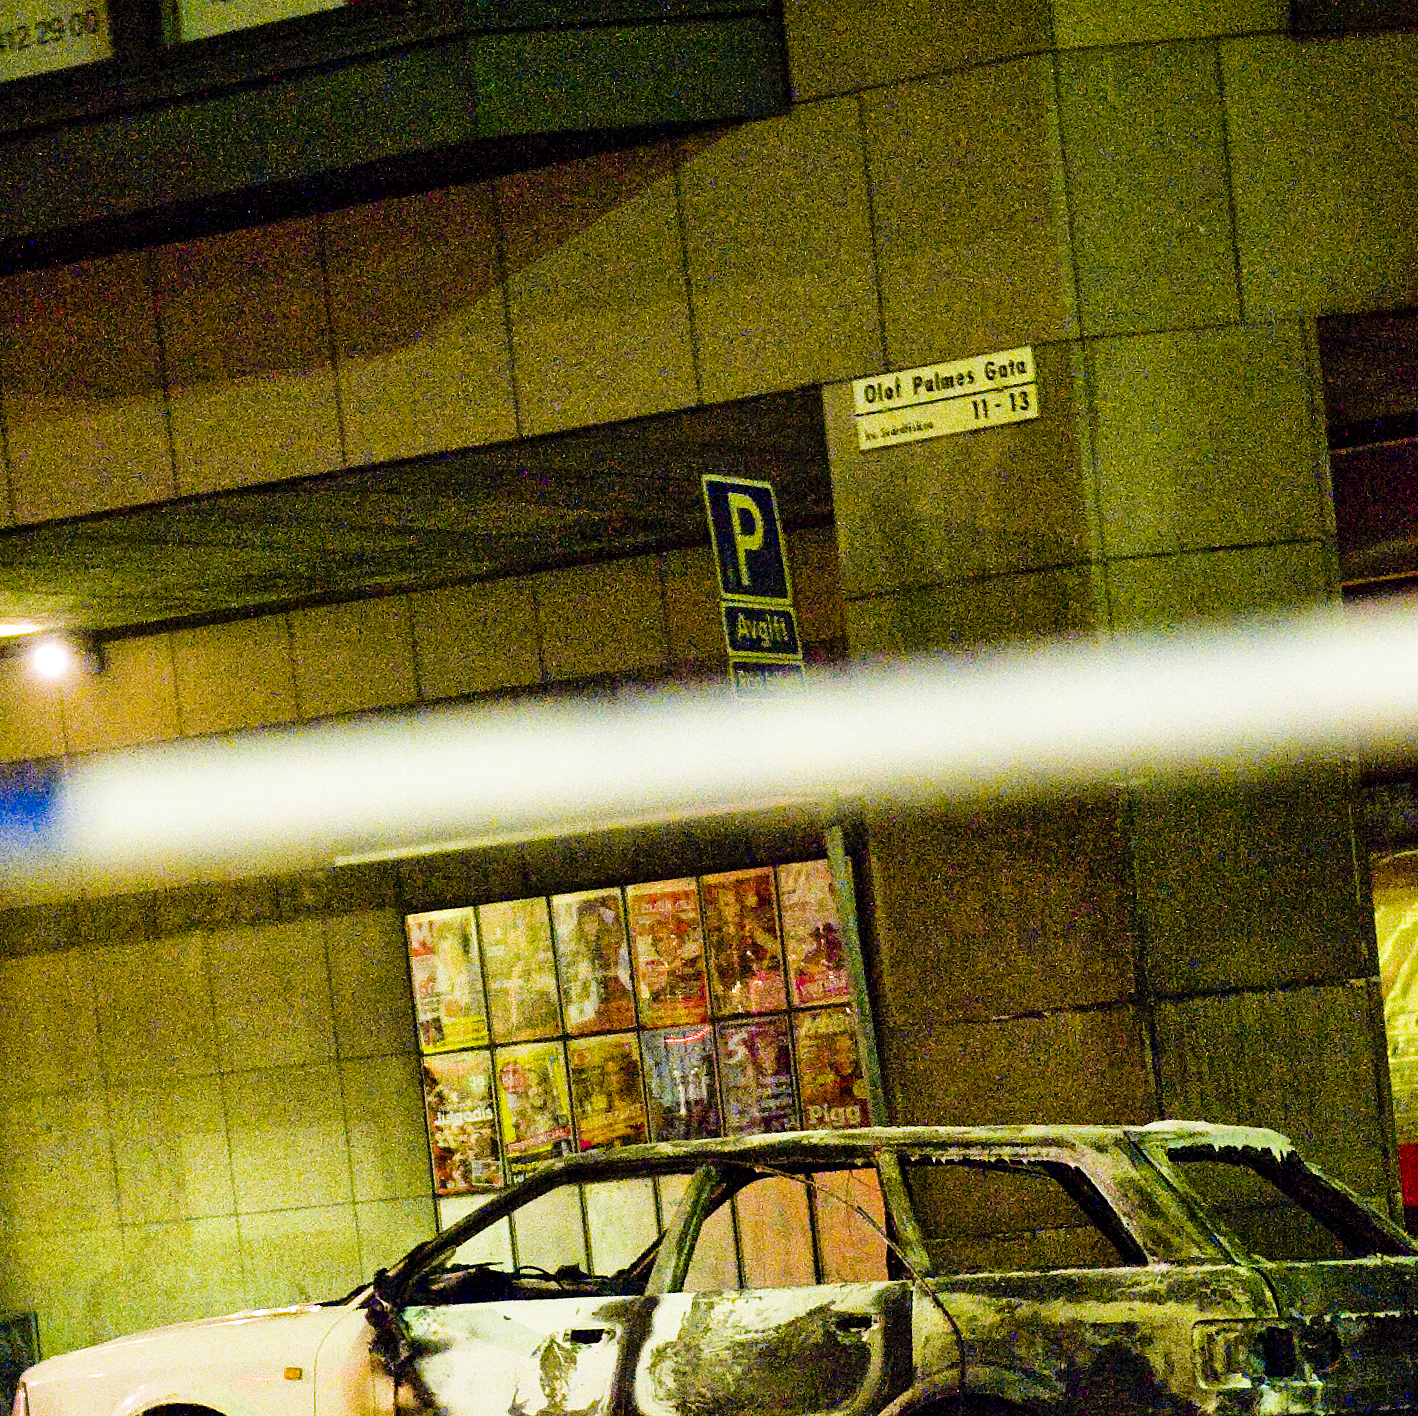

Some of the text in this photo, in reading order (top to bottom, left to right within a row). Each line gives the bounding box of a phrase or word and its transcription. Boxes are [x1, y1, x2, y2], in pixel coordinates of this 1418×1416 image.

[863, 358, 1027, 404] Olof Palmes Gata
[727, 492, 766, 586] P
